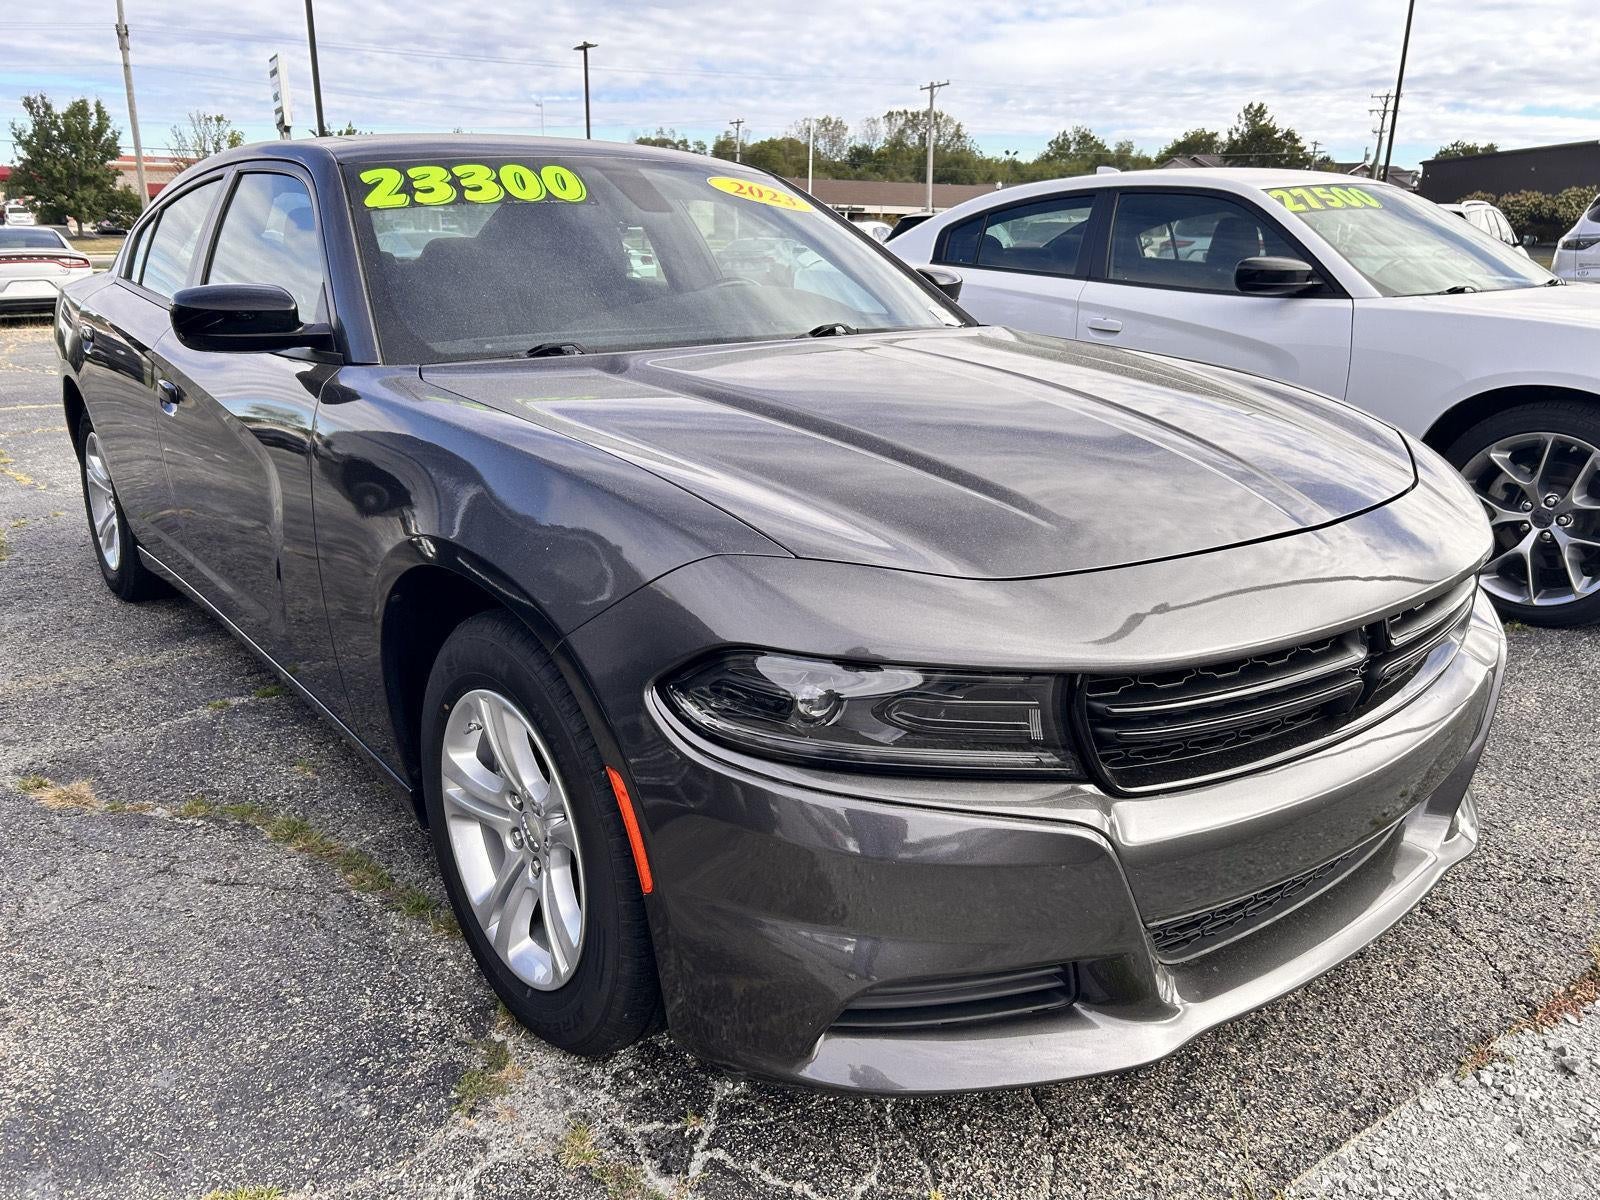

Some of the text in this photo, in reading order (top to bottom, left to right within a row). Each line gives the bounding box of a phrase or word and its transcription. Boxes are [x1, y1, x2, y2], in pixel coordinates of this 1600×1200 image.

[359, 164, 587, 208] 23300
[730, 181, 797, 206] 2023
[1268, 186, 1383, 213] 27500
